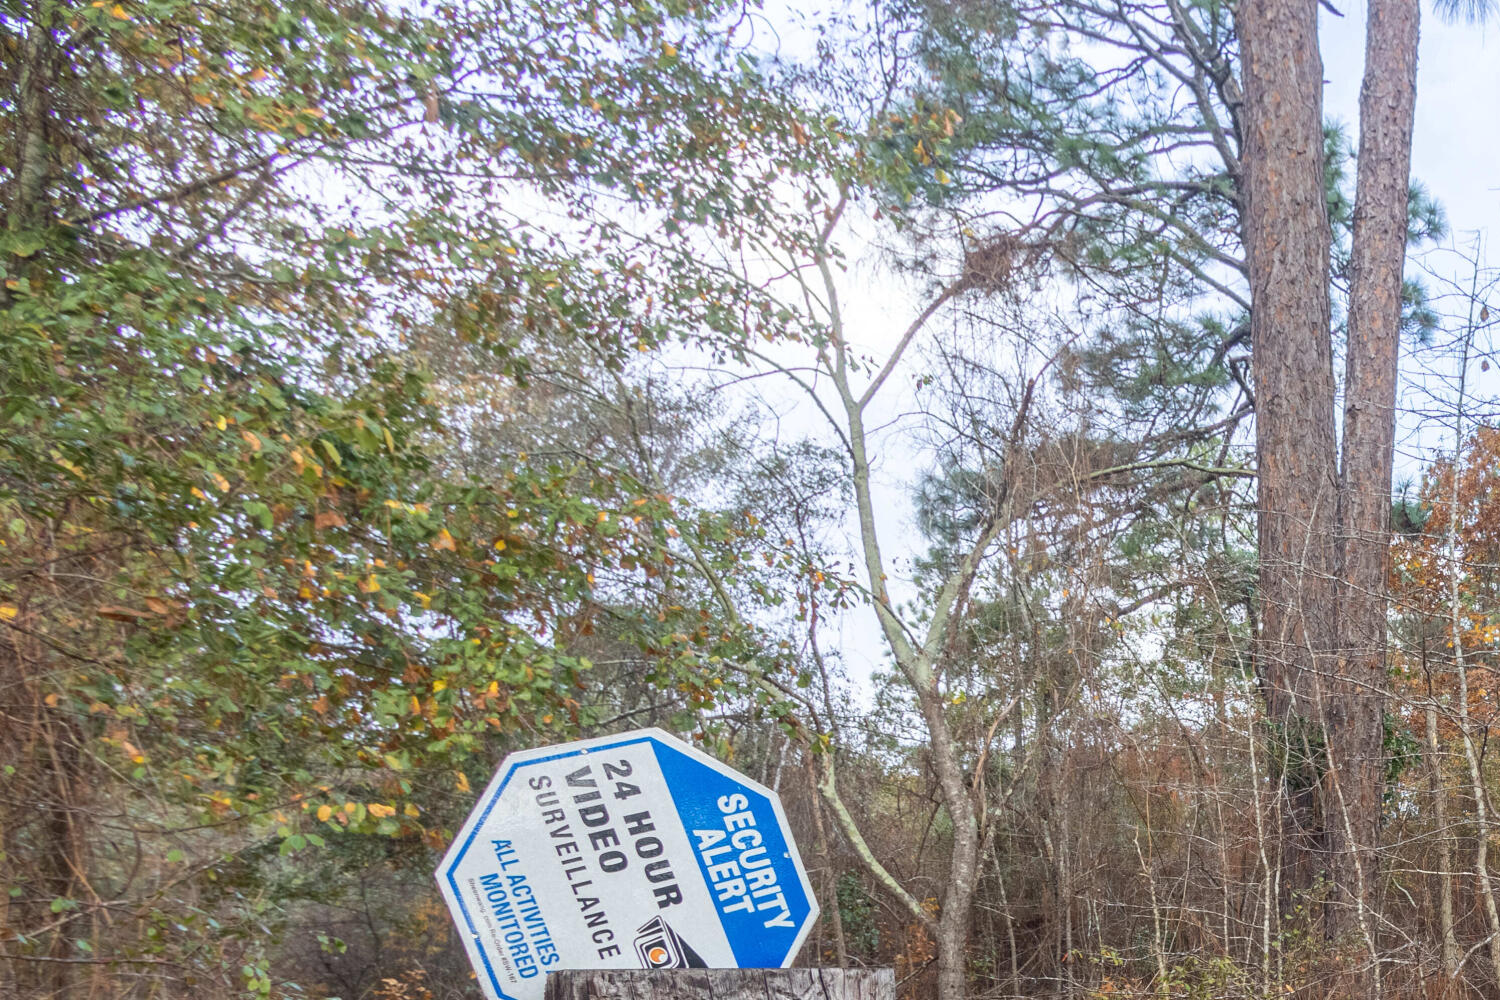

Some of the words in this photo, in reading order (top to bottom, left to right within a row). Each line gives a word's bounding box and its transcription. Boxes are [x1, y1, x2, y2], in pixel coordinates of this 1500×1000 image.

[528, 776, 620, 959] SURVEILLANCE
[565, 765, 628, 873] VIDEO
[604, 759, 642, 800] 24
[623, 811, 683, 909] HOUR
[693, 829, 755, 913] ALERT
[717, 793, 795, 929] SECURITY
[480, 873, 539, 979] MONITORED
[491, 840, 520, 871] ALL
[506, 875, 560, 966] ACTIVITIES
